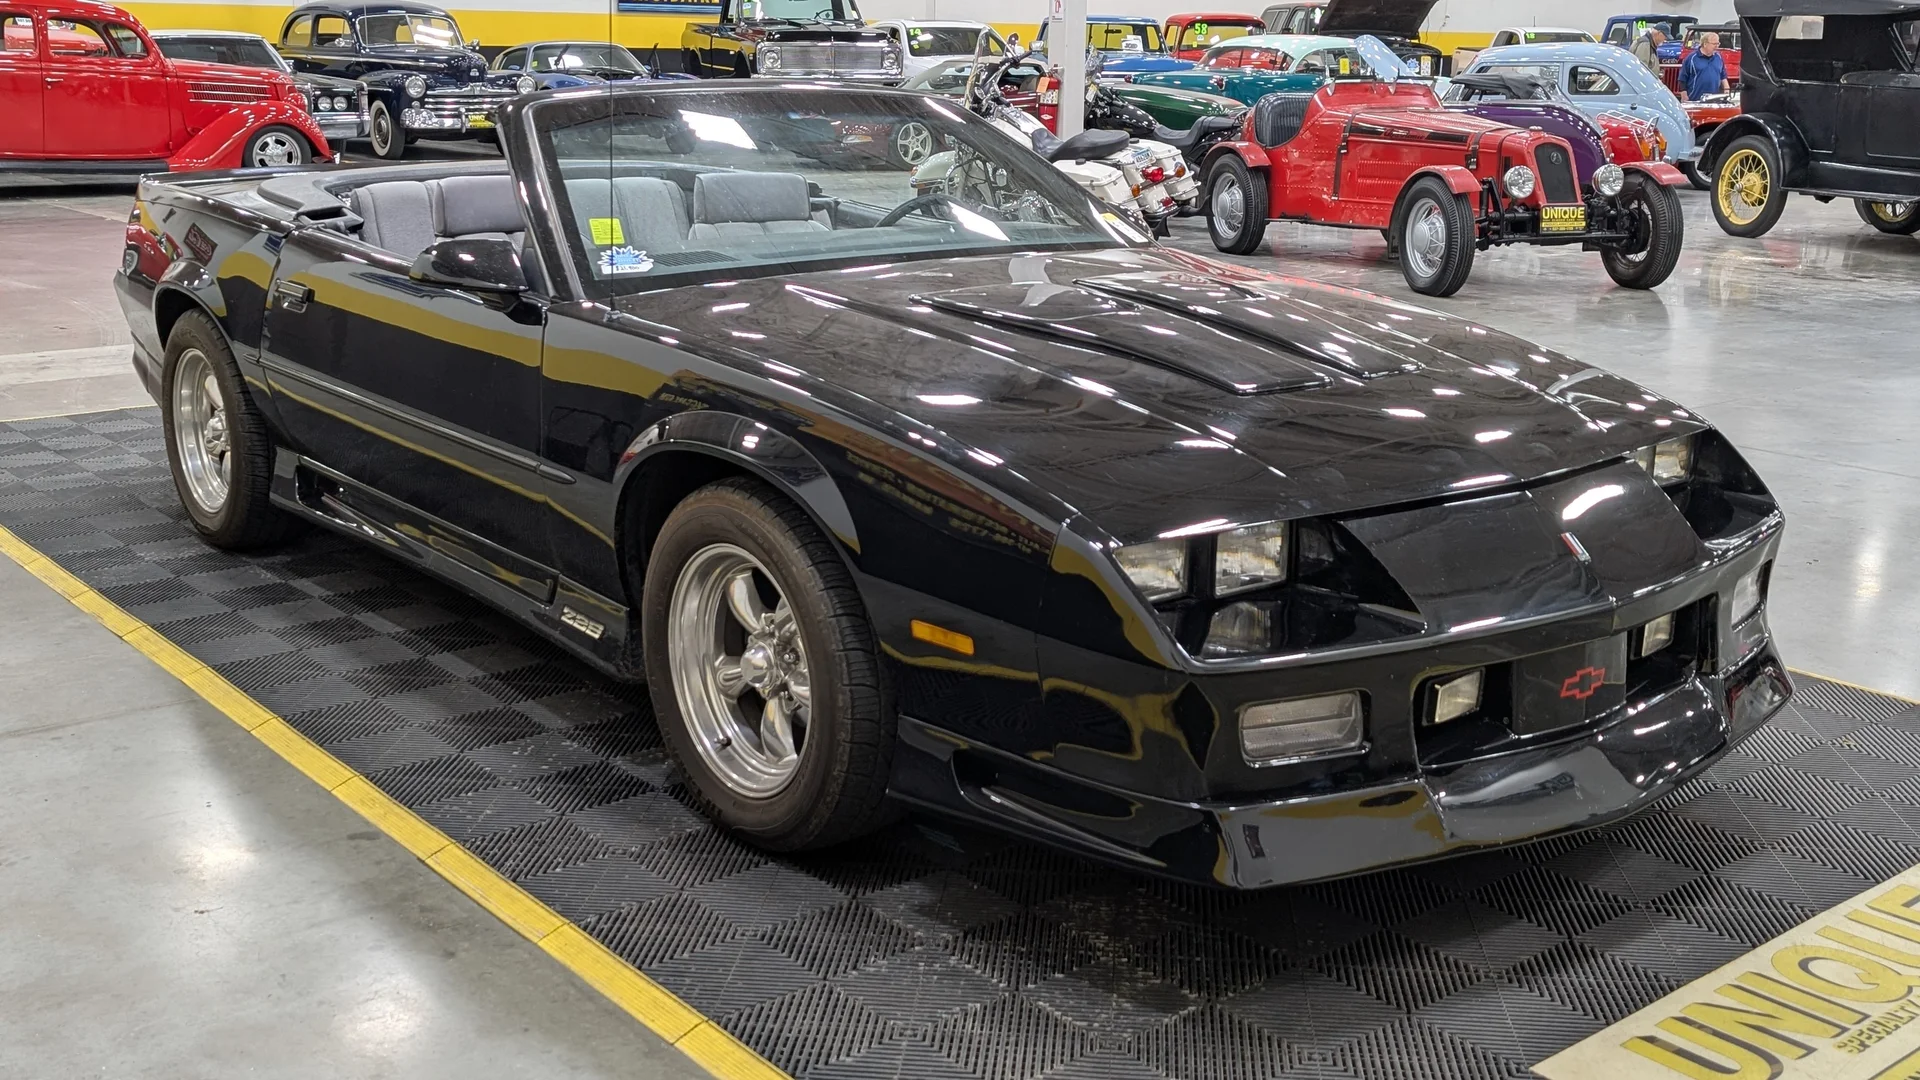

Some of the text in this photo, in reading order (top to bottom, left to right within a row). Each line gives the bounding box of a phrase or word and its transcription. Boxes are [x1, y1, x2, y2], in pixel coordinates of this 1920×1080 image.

[910, 28, 922, 36] 14
[1194, 23, 1208, 35] 58
[1542, 206, 1585, 219] UNIQUE
[560, 605, 605, 640] Z28
